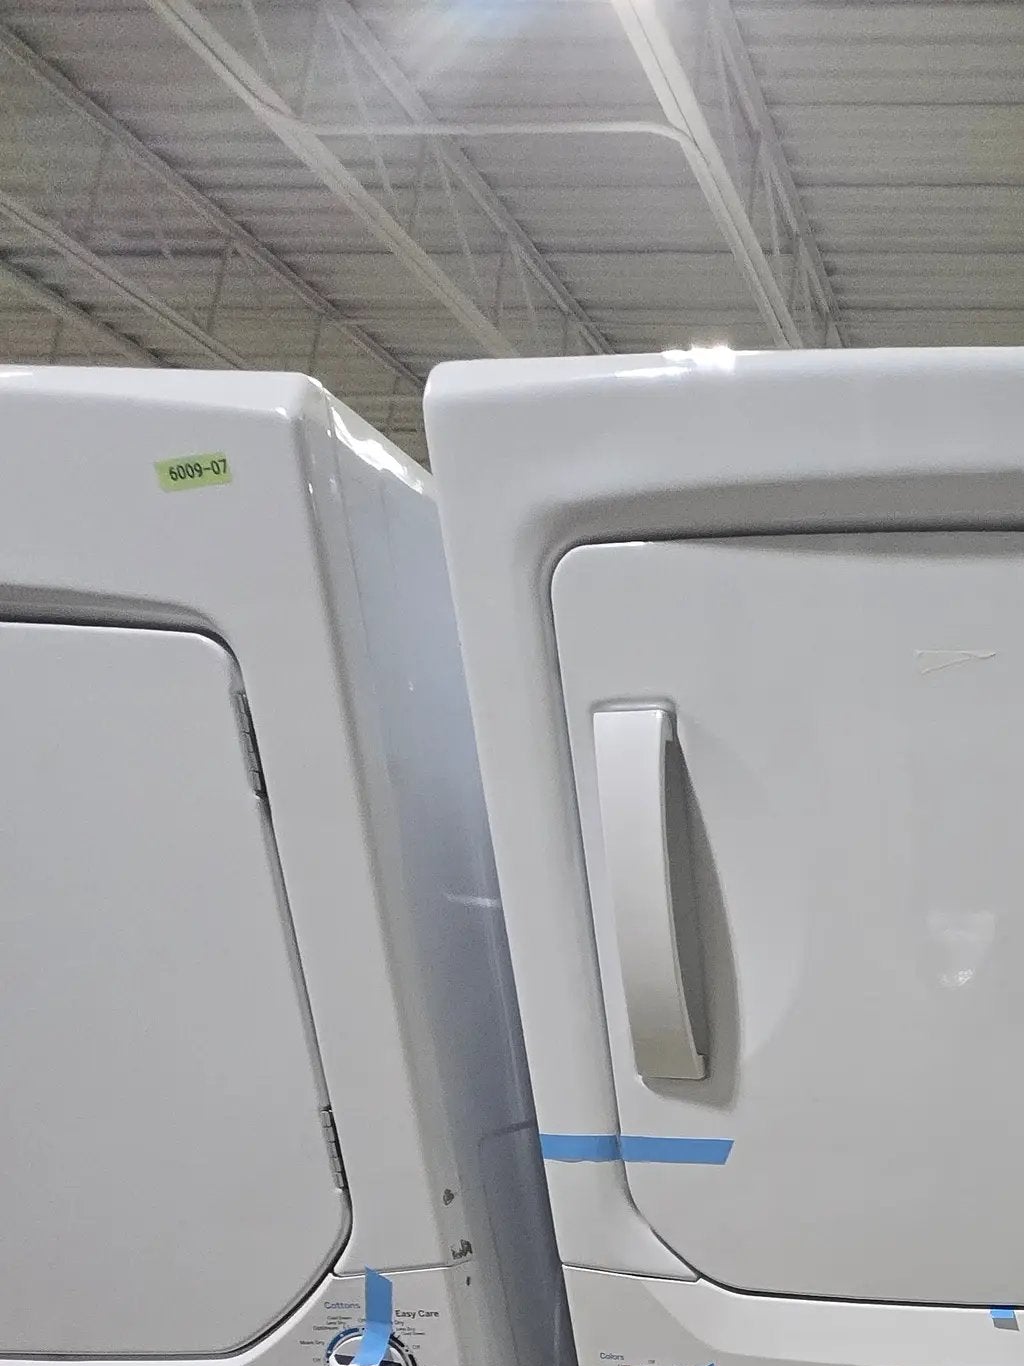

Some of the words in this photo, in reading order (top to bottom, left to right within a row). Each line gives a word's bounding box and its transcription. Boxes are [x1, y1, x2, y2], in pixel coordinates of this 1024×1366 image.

[168, 458, 228, 481] 6009-07
[323, 1301, 361, 1309] Cottons
[395, 1310, 417, 1319] Easy
[418, 1310, 440, 1318] Care
[600, 1352, 624, 1361] Colors
